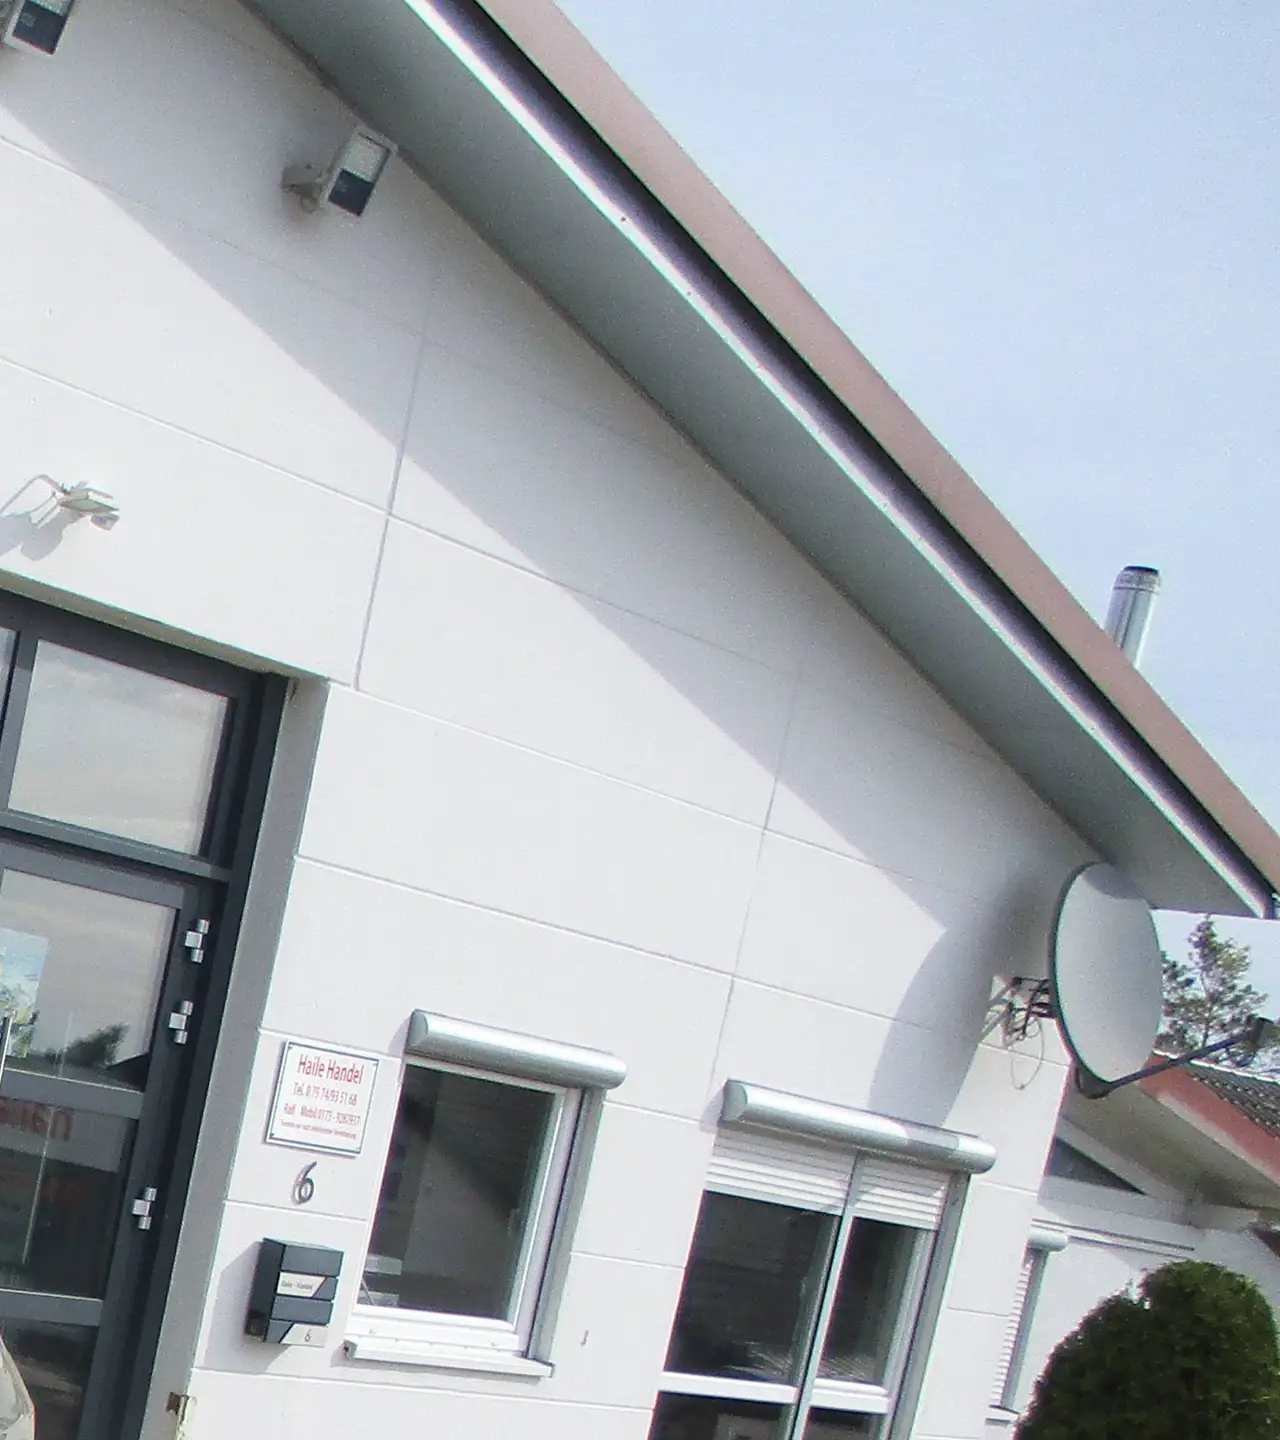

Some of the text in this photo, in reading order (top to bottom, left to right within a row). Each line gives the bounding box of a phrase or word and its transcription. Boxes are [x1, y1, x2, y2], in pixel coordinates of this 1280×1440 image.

[297, 1053, 365, 1085] Haile Handel
[297, 1160, 318, 1205] 6
[305, 1328, 313, 1343] 6
